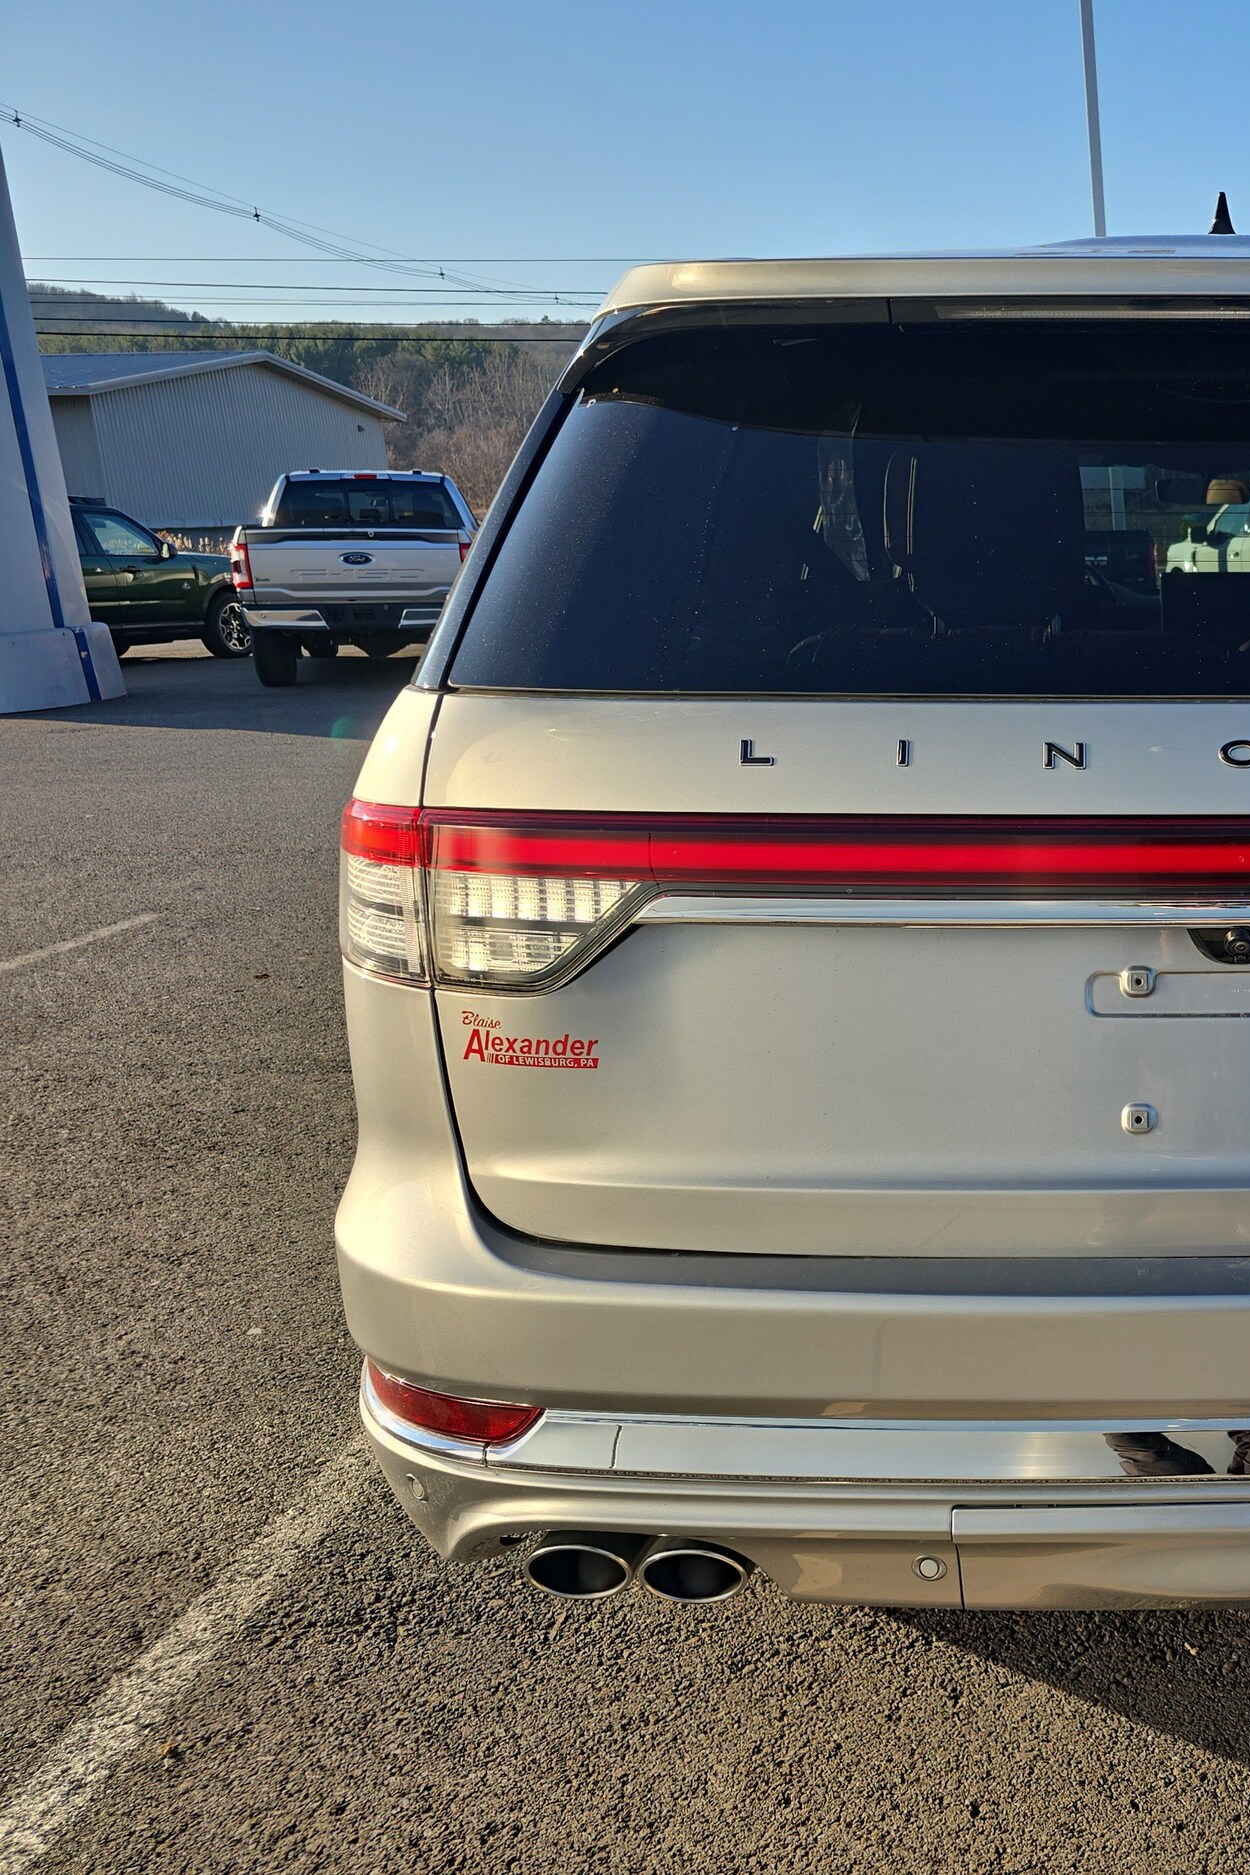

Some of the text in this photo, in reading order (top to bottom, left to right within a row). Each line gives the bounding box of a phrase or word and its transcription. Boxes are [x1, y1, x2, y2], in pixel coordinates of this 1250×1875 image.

[290, 568, 425, 582] F-150
[461, 1010, 502, 1030] Blaise
[463, 1028, 600, 1063] Alexander
[497, 1054, 595, 1068] OF LEWISBURG, PA
